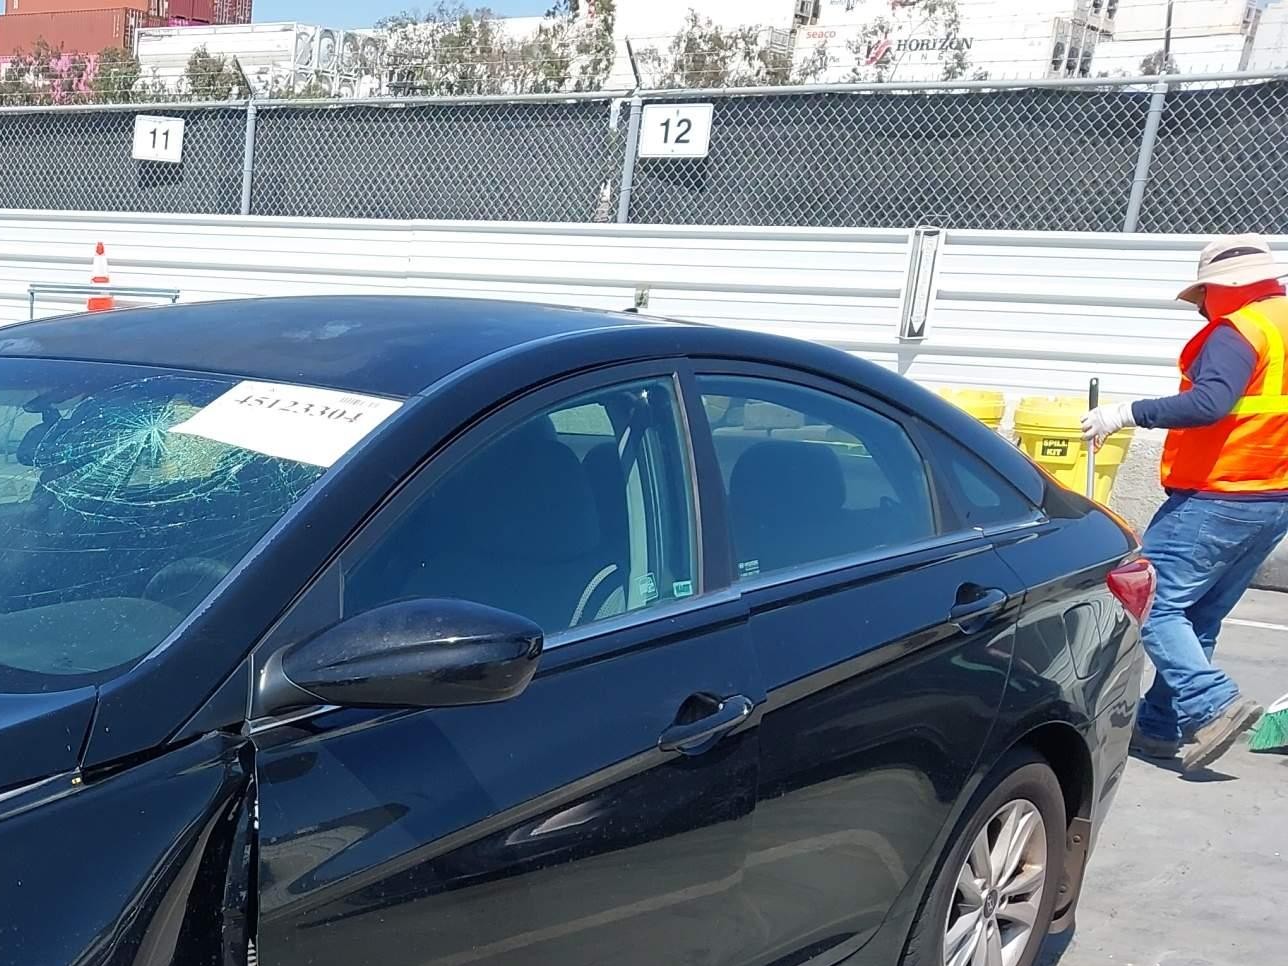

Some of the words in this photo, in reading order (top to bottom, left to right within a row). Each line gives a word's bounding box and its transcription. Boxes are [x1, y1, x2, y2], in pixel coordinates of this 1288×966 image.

[806, 31, 836, 39] seaco
[896, 37, 974, 52] HORIZON
[149, 128, 169, 151] 11
[660, 118, 692, 144] 12
[234, 395, 363, 423] 45123304
[1047, 448, 1062, 456] KIT
